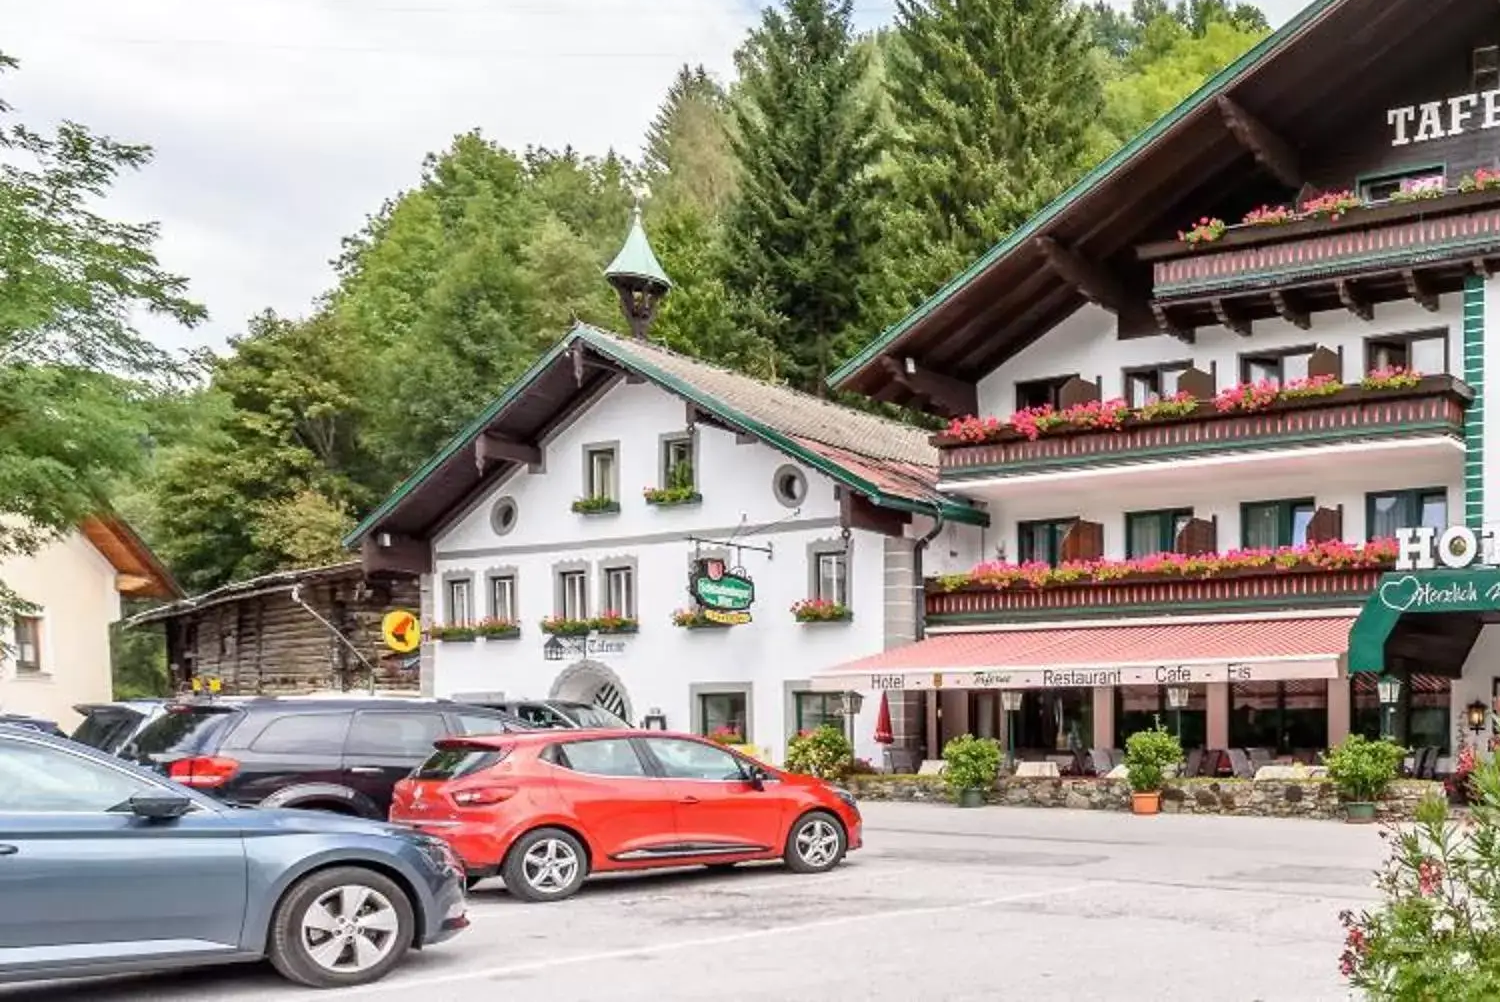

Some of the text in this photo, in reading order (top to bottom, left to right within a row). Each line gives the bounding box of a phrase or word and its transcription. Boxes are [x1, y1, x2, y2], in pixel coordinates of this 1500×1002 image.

[1416, 581, 1478, 606] Herzlich
[871, 673, 906, 690] Hotel
[1043, 669, 1122, 686] Restaurant
[1155, 665, 1192, 683] Cafe
[1227, 663, 1251, 680] Eis
